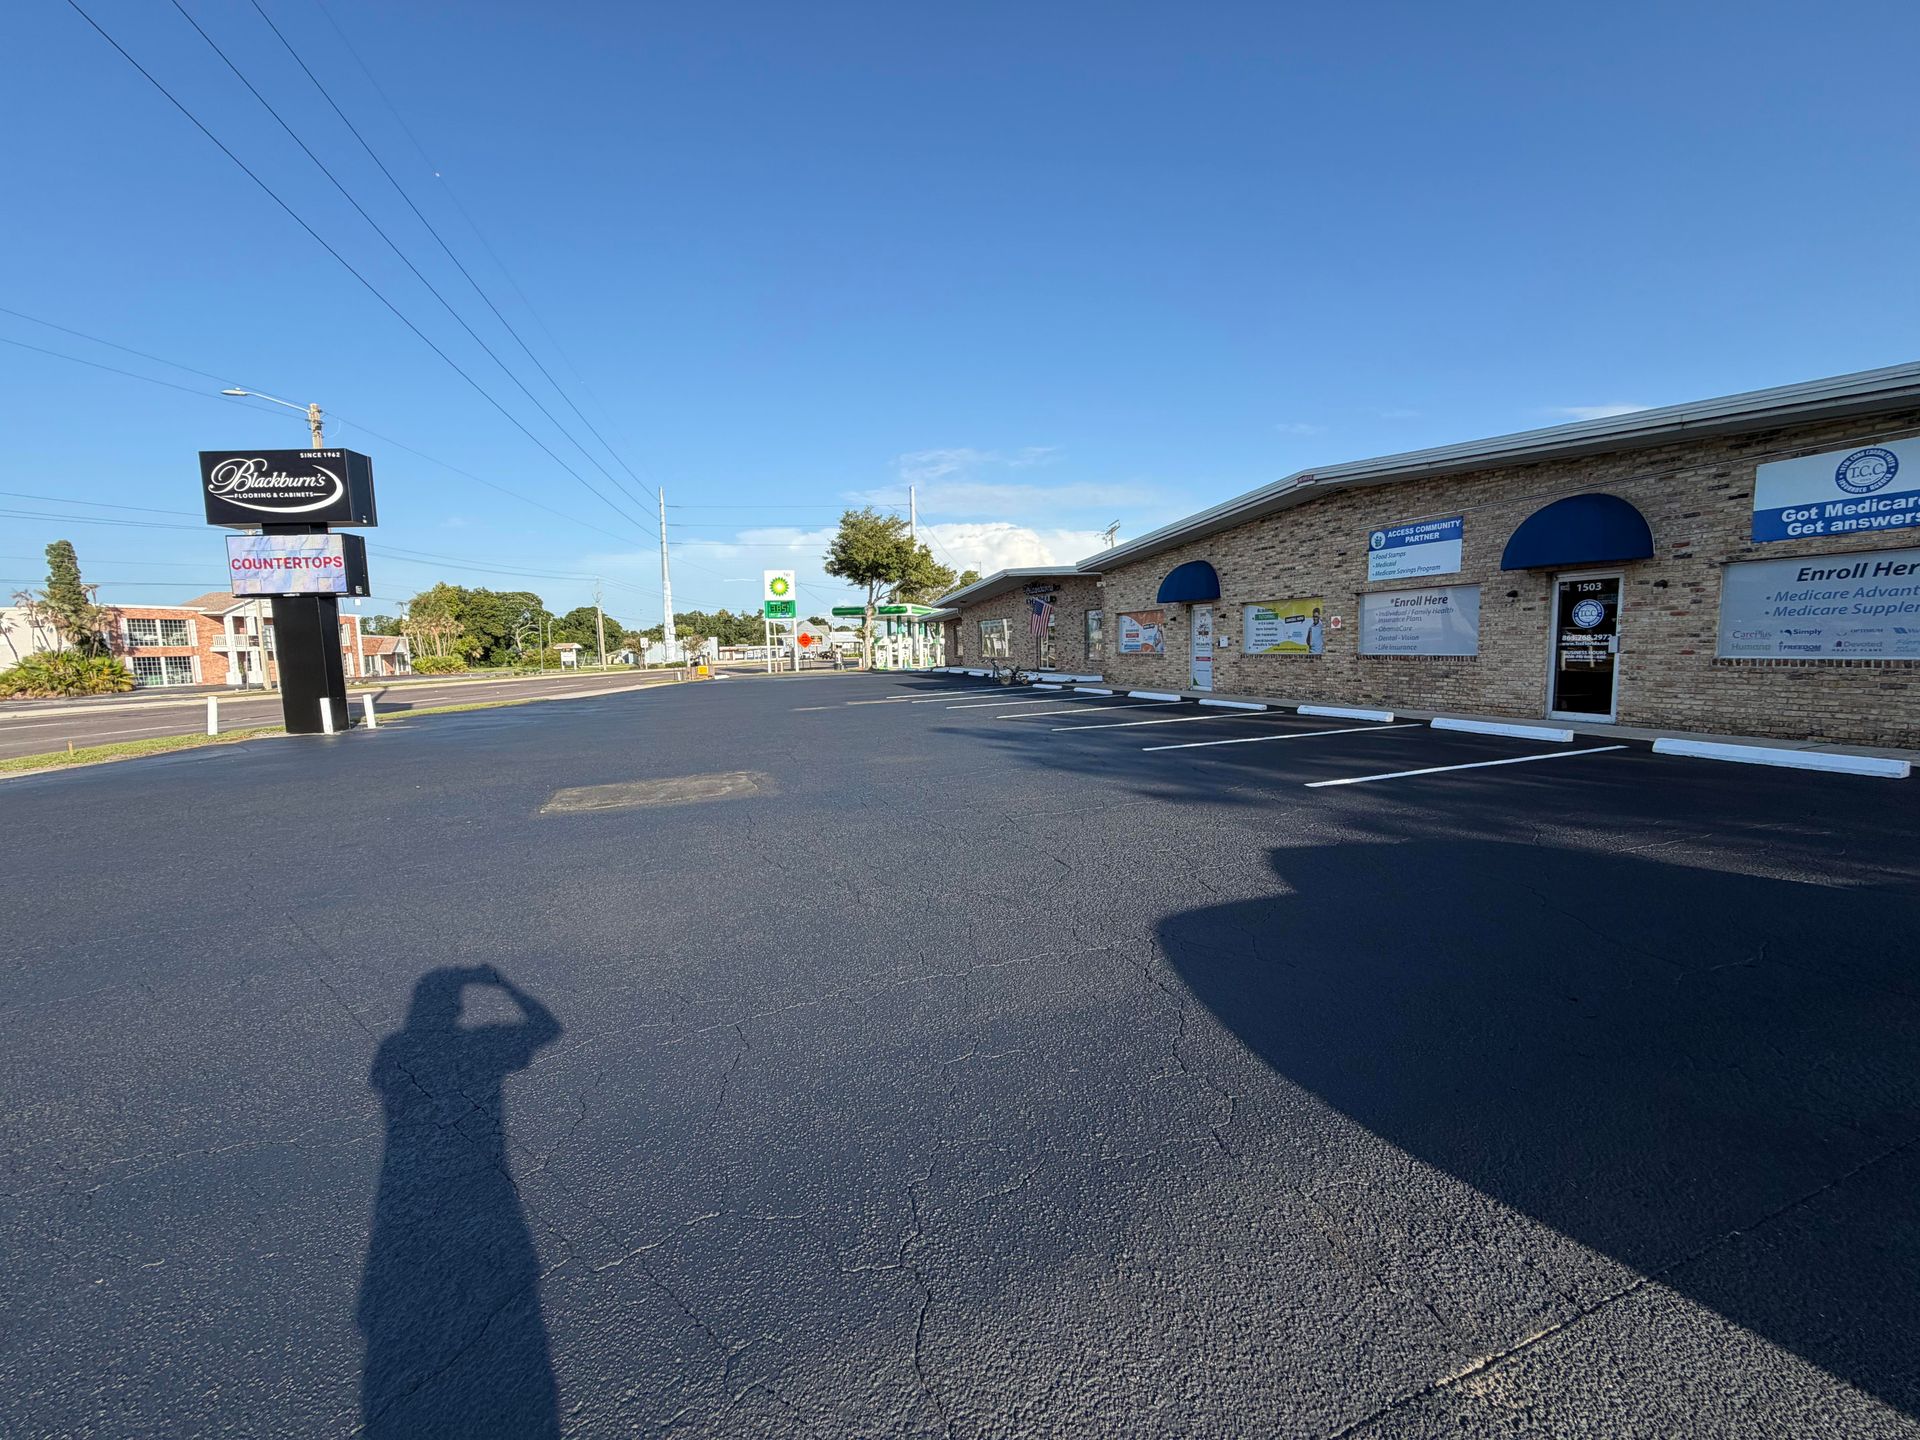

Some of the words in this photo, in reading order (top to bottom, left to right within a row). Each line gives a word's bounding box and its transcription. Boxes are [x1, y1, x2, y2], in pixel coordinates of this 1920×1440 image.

[208, 458, 326, 493] Blackburn's
[1782, 506, 1819, 522] Got
[1825, 496, 1920, 518] Medicar
[1388, 528, 1414, 538] ACCESS
[1415, 520, 1461, 533] COMMUNITY
[1787, 520, 1824, 535] Get
[1405, 532, 1440, 543] PARTNER
[1376, 552, 1387, 560] Food
[1388, 551, 1406, 559] Stamps
[232, 556, 342, 570] COUNTERTOPS
[1796, 562, 1868, 582] Enroll
[1577, 582, 1602, 592] 1503
[1424, 596, 1448, 604] Here
[1774, 590, 1849, 602] Medicare
[1411, 608, 1431, 616] Family
[1773, 605, 1850, 616] Medicare
[1793, 628, 1822, 636] Simply
